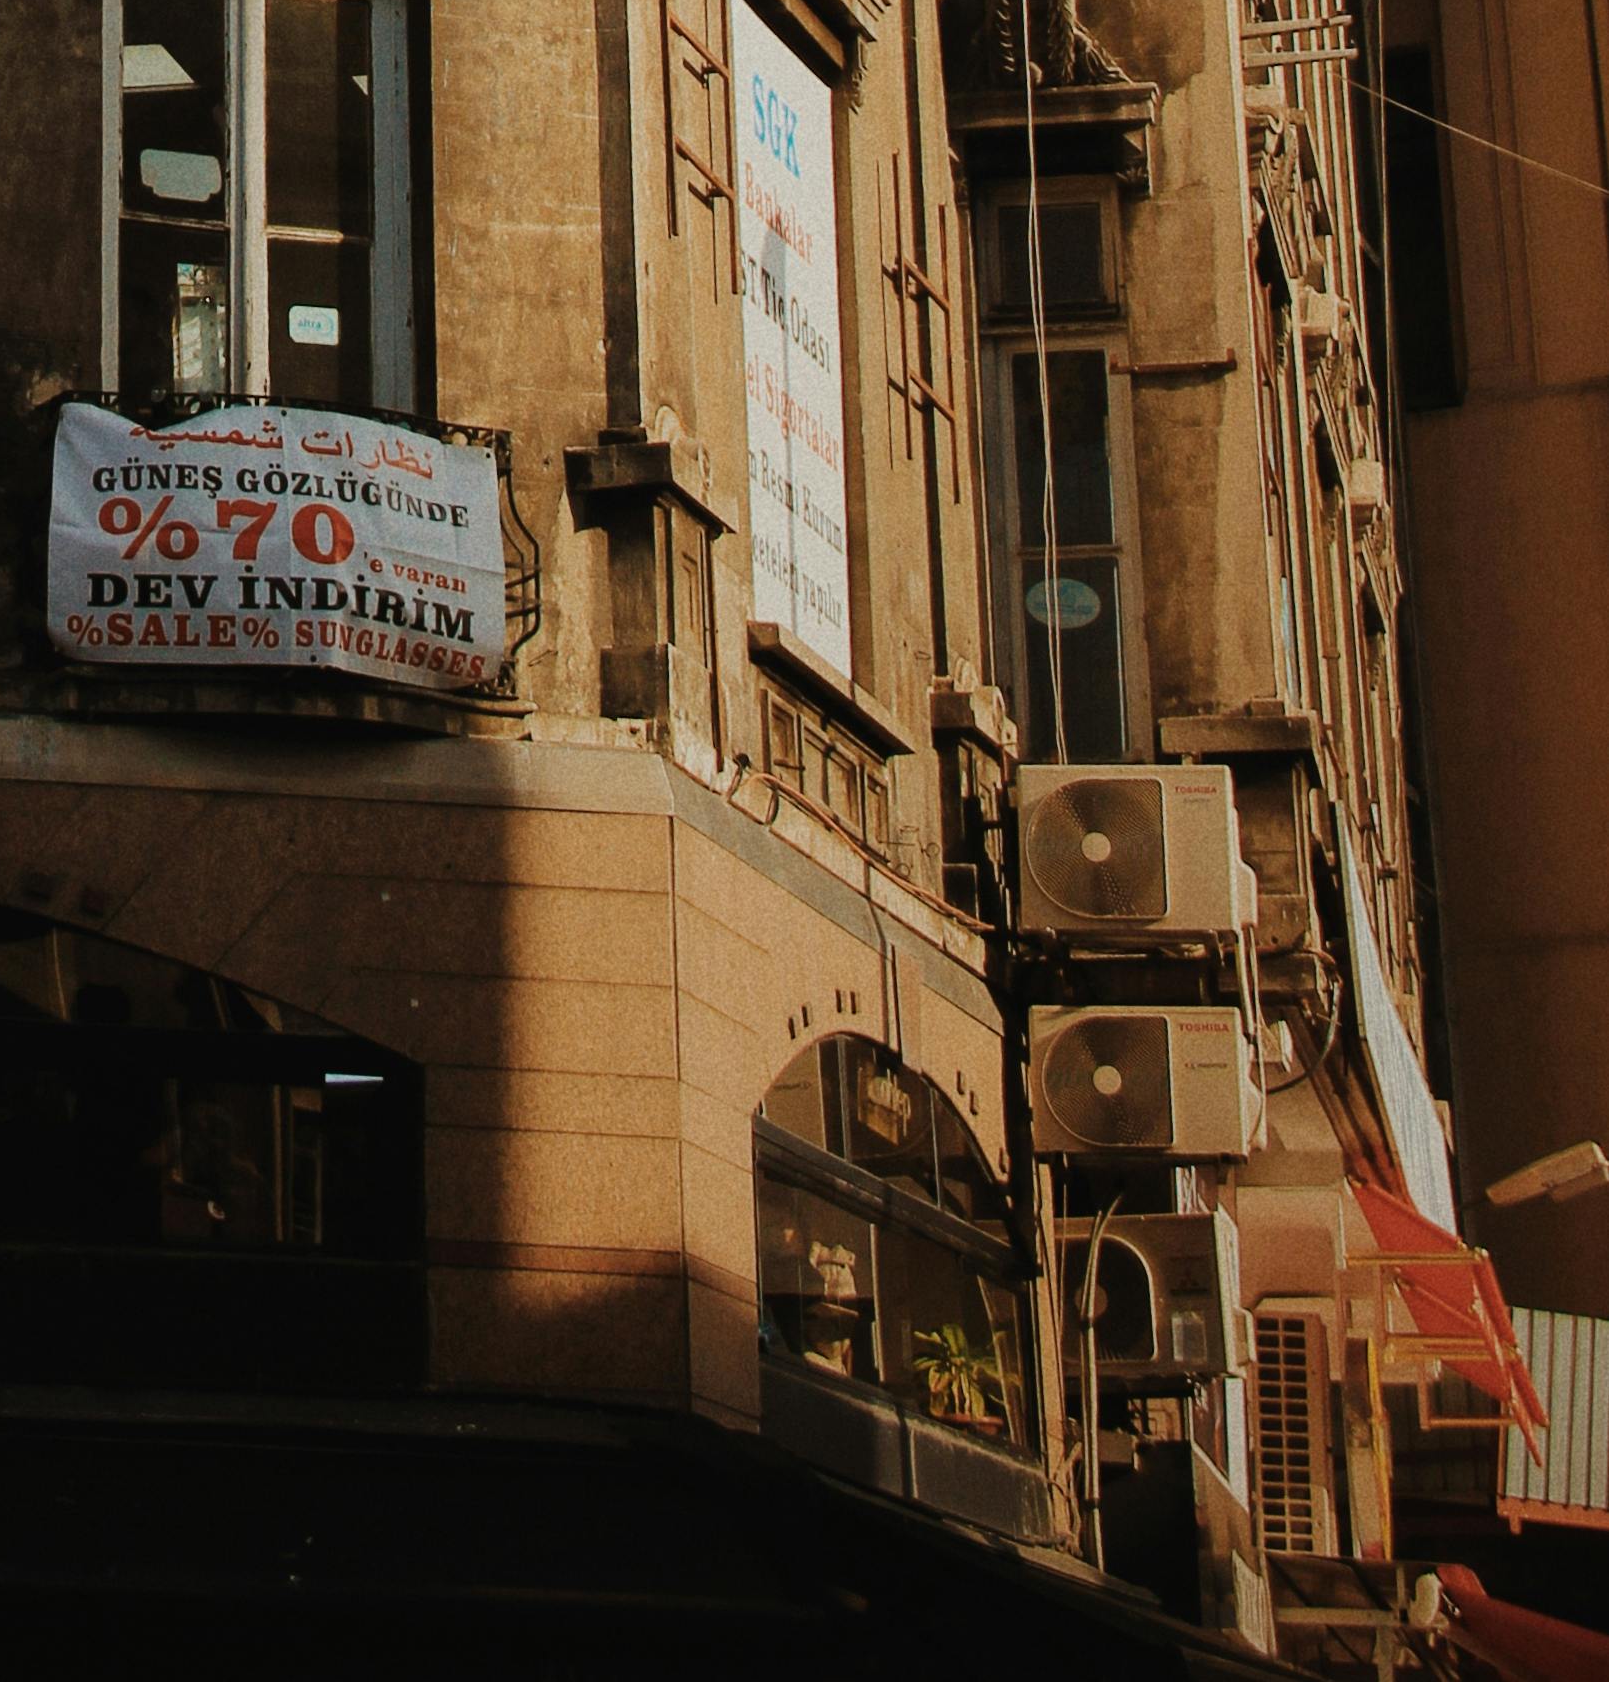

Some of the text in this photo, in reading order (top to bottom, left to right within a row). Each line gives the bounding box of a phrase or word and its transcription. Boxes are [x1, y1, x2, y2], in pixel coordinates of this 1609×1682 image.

[752, 73, 800, 178] SGK
[745, 159, 812, 264] Bankalar
[764, 361, 839, 472] Sigortalar
[93, 458, 470, 529] GÜNEŞ GÖZLÜĞÜNDE
[800, 483, 842, 554] Kurum
[88, 565, 474, 643] DEV İNDİRİM
[392, 564, 467, 594] varan
[295, 620, 485, 679] SUNGLASSES
